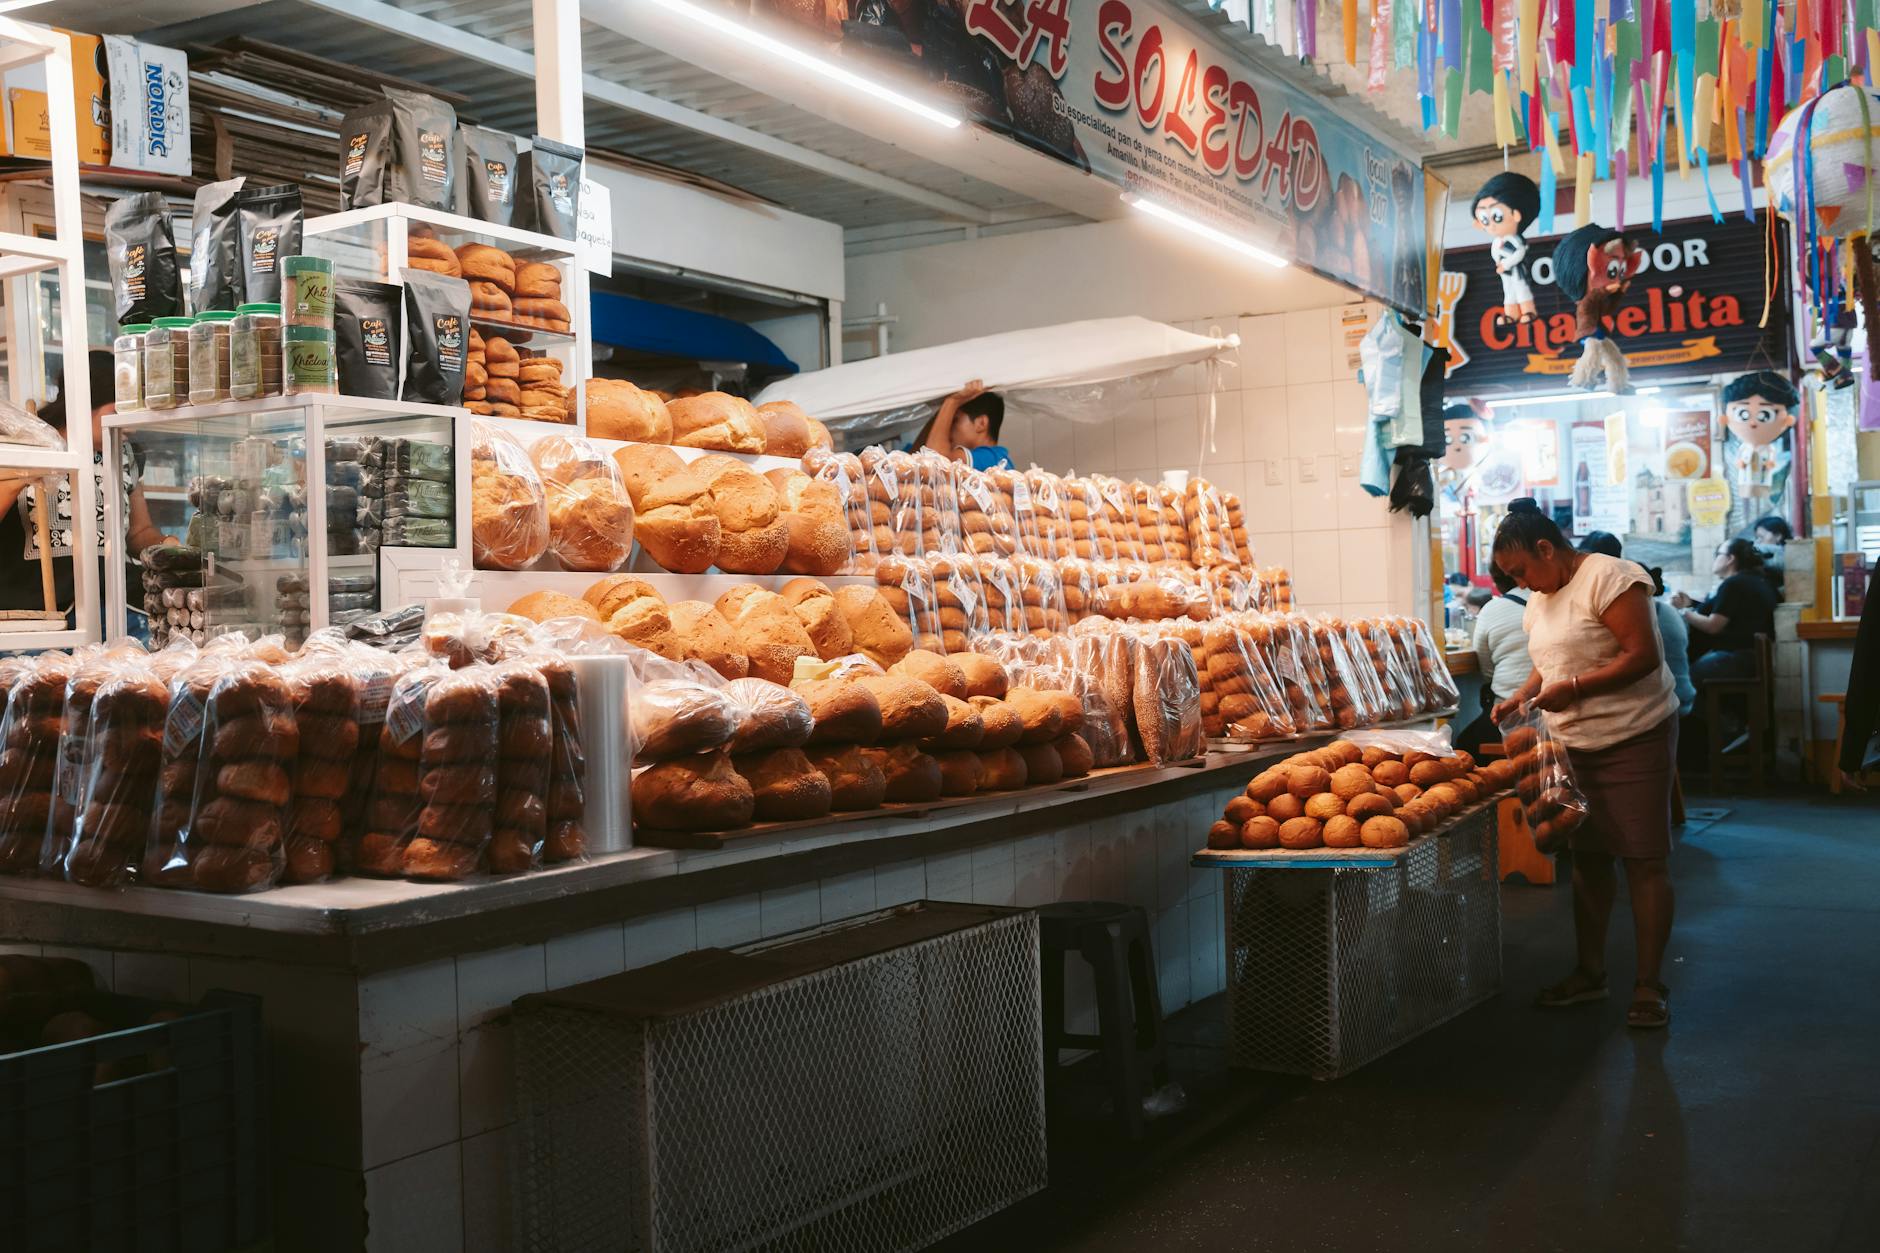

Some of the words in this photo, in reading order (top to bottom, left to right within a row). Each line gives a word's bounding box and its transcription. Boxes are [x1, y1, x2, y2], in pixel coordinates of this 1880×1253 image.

[145, 62, 167, 157] NORDIC
[966, 0, 1068, 80] LA
[1092, 0, 1321, 211] SOLEDAD
[1054, 93, 1065, 112] Su
[1068, 105, 1116, 139] especialidad
[1118, 131, 1131, 147] pan
[1133, 138, 1142, 152] de
[1143, 145, 1162, 161] yema
[1164, 154, 1176, 168] con
[1480, 285, 1744, 356] Chaelita
